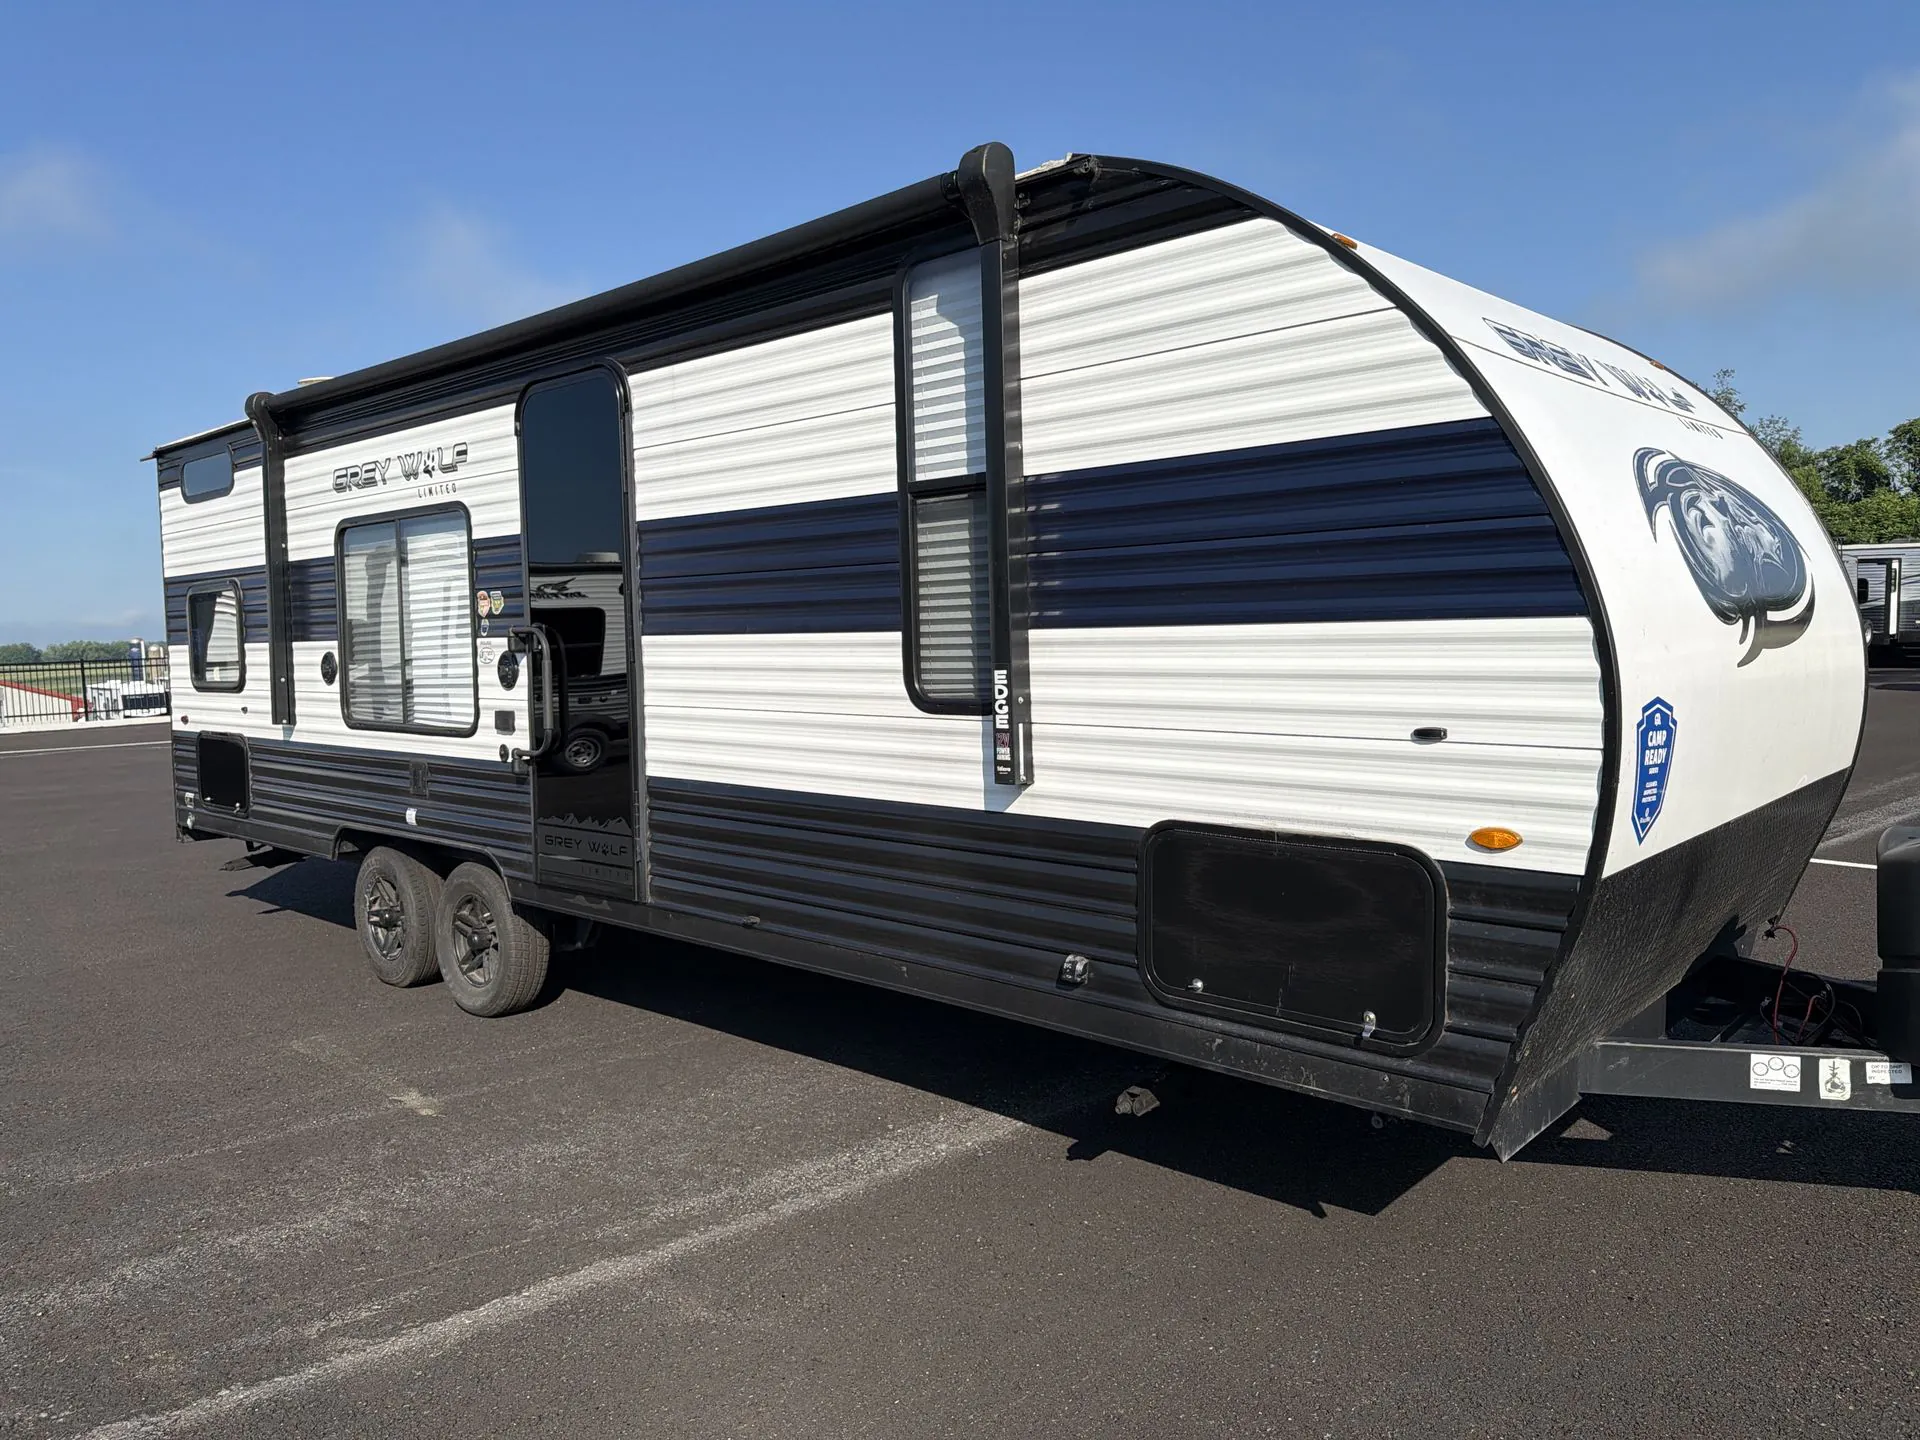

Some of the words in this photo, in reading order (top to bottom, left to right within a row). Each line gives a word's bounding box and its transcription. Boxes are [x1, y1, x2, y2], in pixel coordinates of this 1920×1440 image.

[332, 457, 391, 494] GREY
[417, 483, 457, 499] LIMITED
[994, 669, 1009, 729] EDGE
[1648, 730, 1667, 747] CAMP
[1644, 748, 1668, 766] READY
[544, 834, 582, 851] GREY
